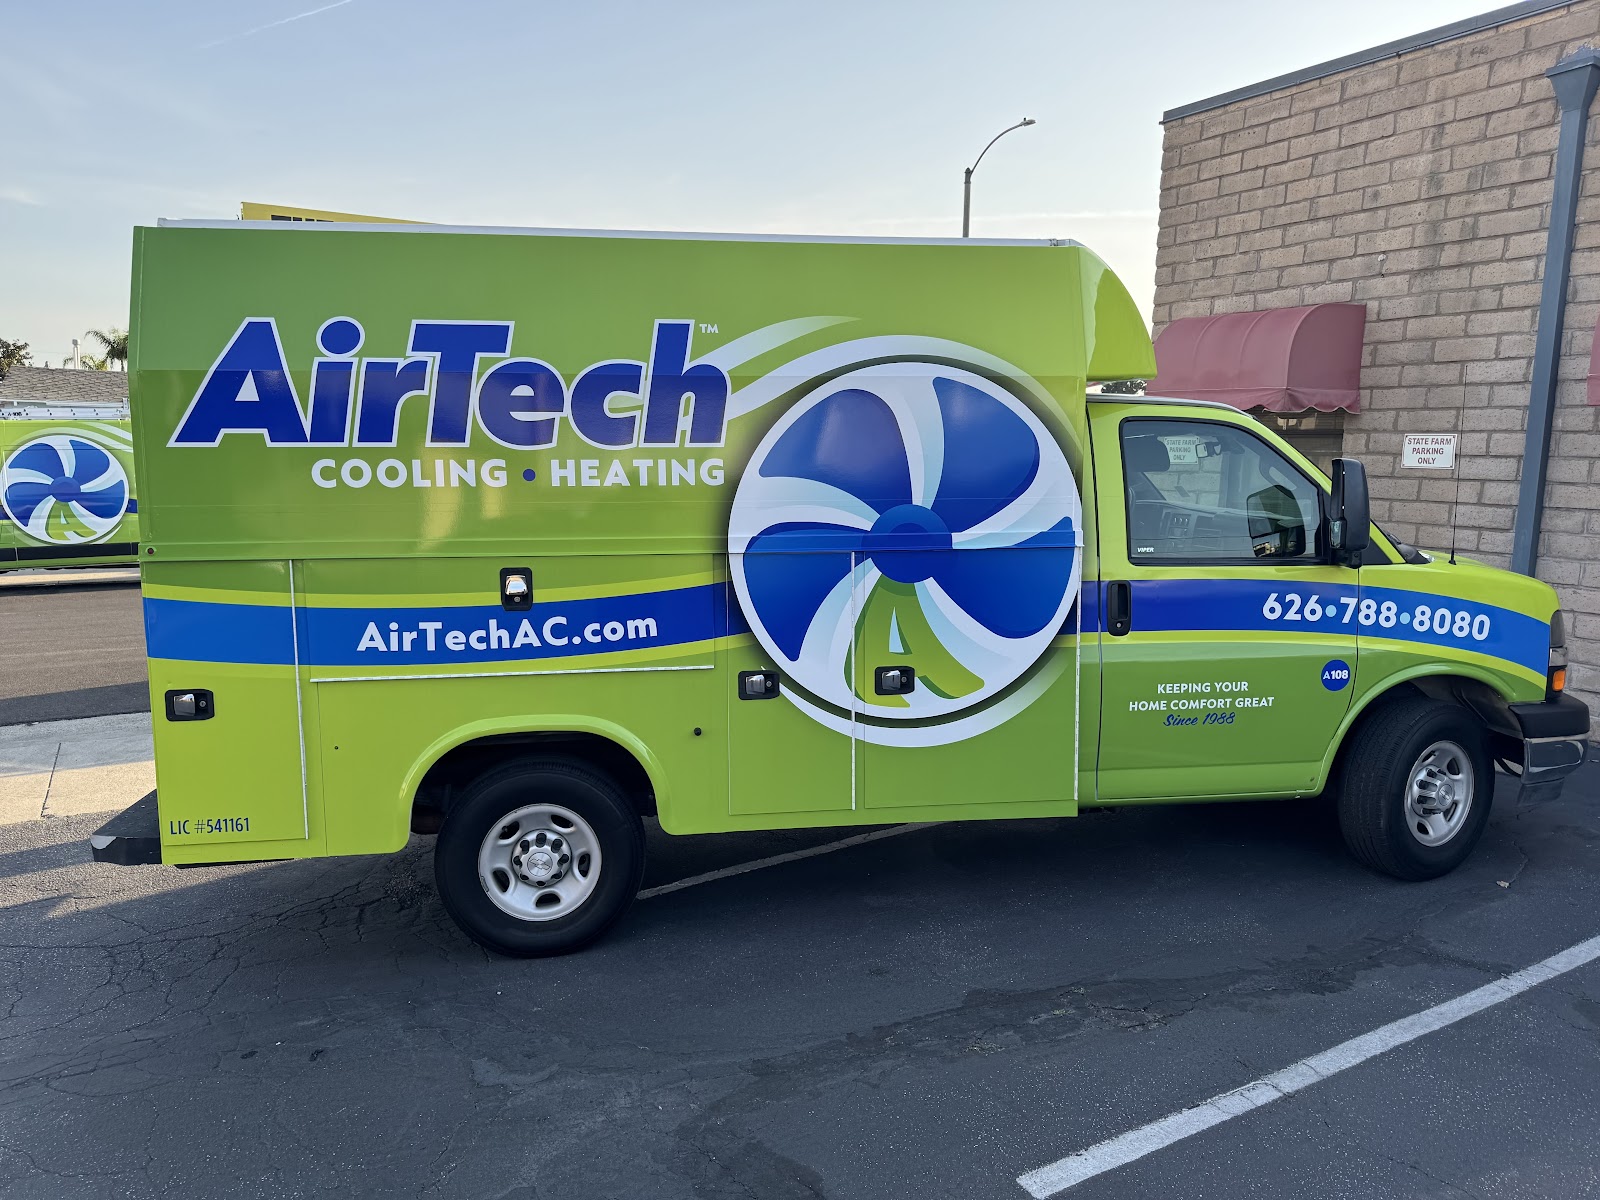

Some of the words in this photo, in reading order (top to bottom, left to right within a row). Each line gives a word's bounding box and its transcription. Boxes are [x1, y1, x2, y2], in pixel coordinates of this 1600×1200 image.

[166, 316, 731, 450] AirTech
[699, 323, 719, 334] TM
[1407, 437, 1430, 446] STATE
[1430, 437, 1452, 446] FARM
[1411, 447, 1444, 455] PARKING
[1417, 457, 1437, 465] ONLY
[311, 458, 508, 488] COOLING
[550, 458, 725, 487] HEATING
[356, 616, 658, 652] AirTechAC.com
[1322, 669, 1349, 681] A108
[1157, 682, 1211, 694] KEEPING
[1214, 681, 1249, 692] YOUR
[1129, 701, 1167, 711] HOME
[1170, 698, 1232, 710] COMFORT
[1235, 696, 1275, 708] GREAT
[1163, 713, 1198, 726] Since
[1202, 711, 1236, 725] 1988
[170, 820, 190, 835] LIC
[194, 817, 249, 834] #541161
